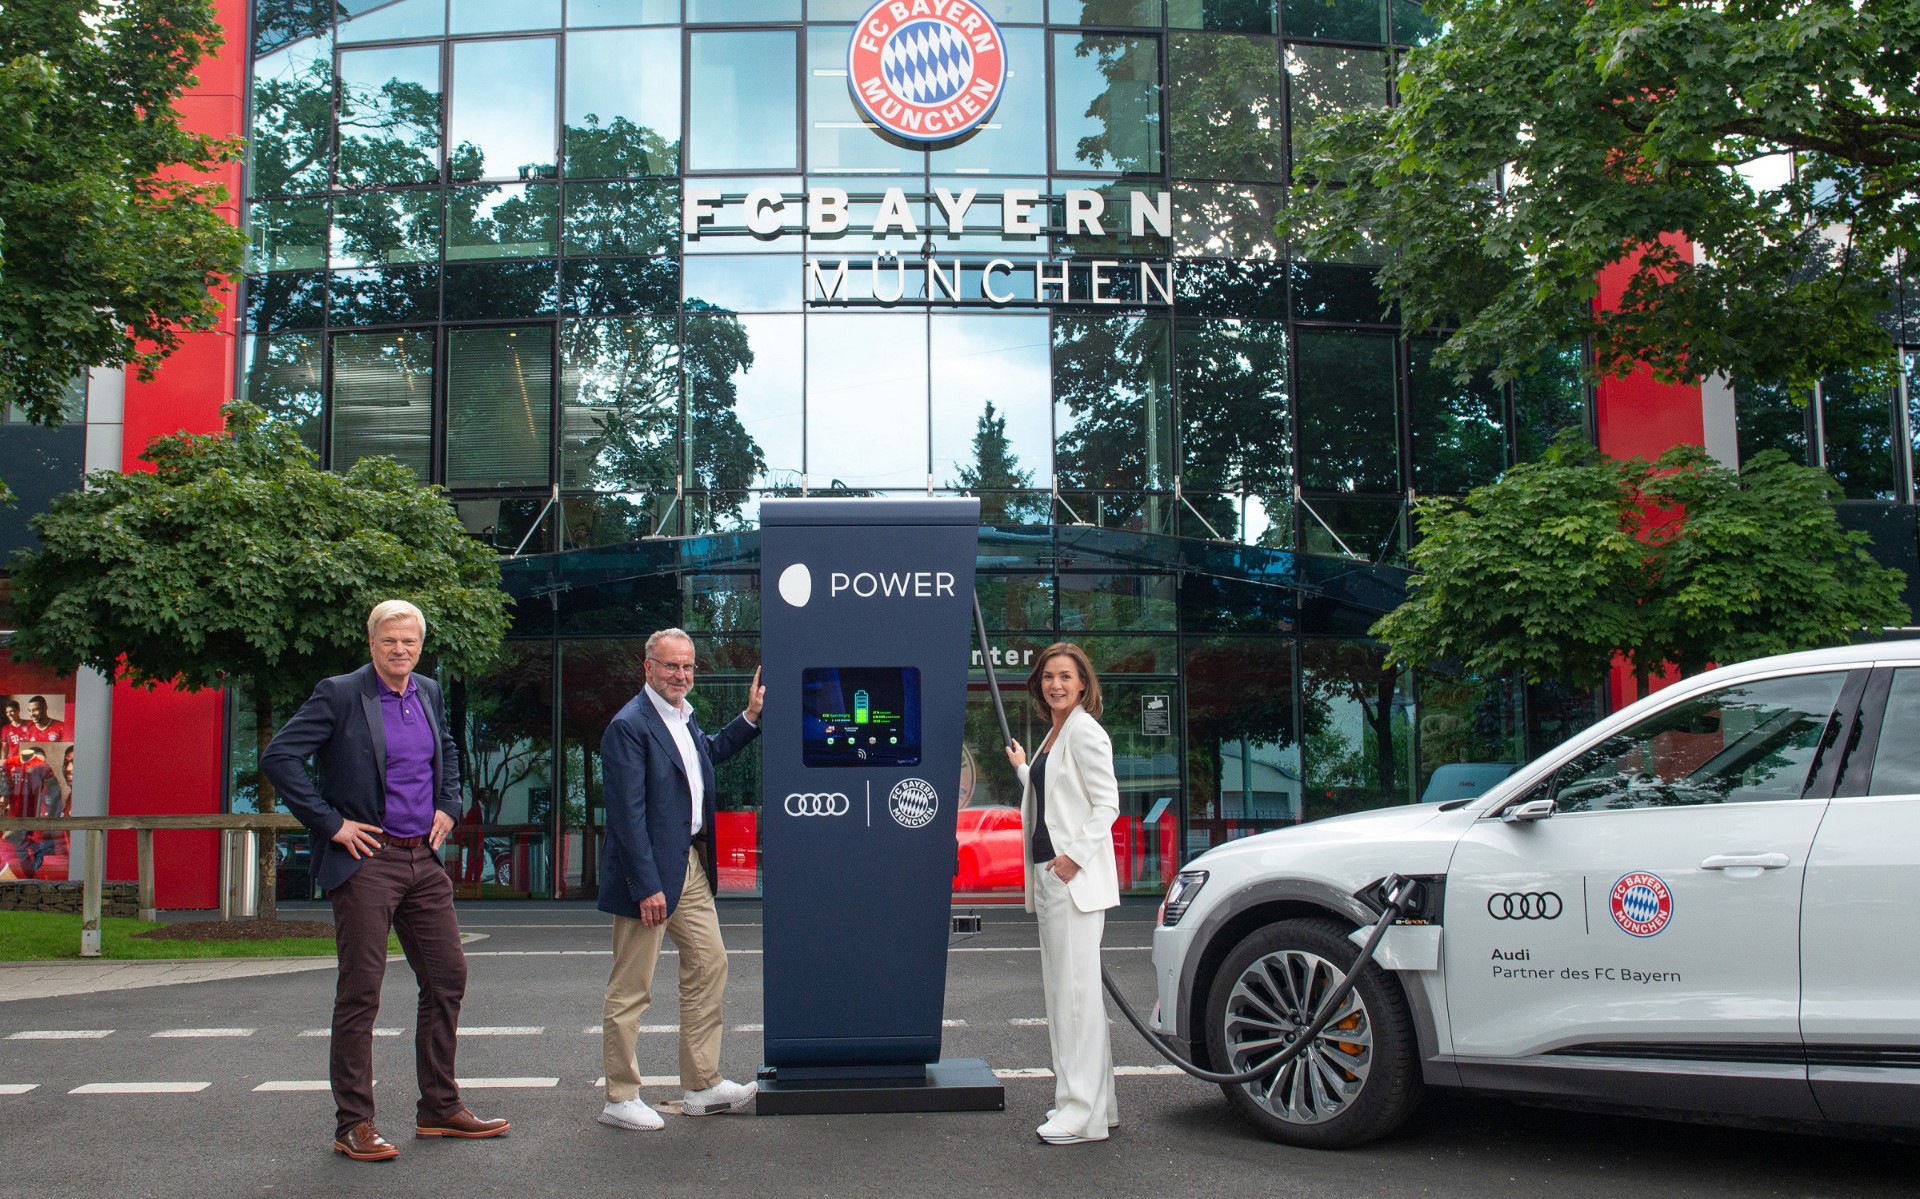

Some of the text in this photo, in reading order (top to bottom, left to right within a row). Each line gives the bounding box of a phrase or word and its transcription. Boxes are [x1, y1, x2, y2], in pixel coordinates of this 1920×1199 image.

[859, 0, 996, 54] FC BAYERN
[861, 76, 995, 131] MÜNCHEN
[809, 248, 1175, 306] MÜNCHEN
[831, 572, 955, 597] POWER
[891, 781, 934, 800] FC BAYERN
[1613, 875, 1667, 900] FC BAYERN
[1491, 948, 1531, 961] Audi
[1493, 965, 1681, 984] Partner des FC Bayern
